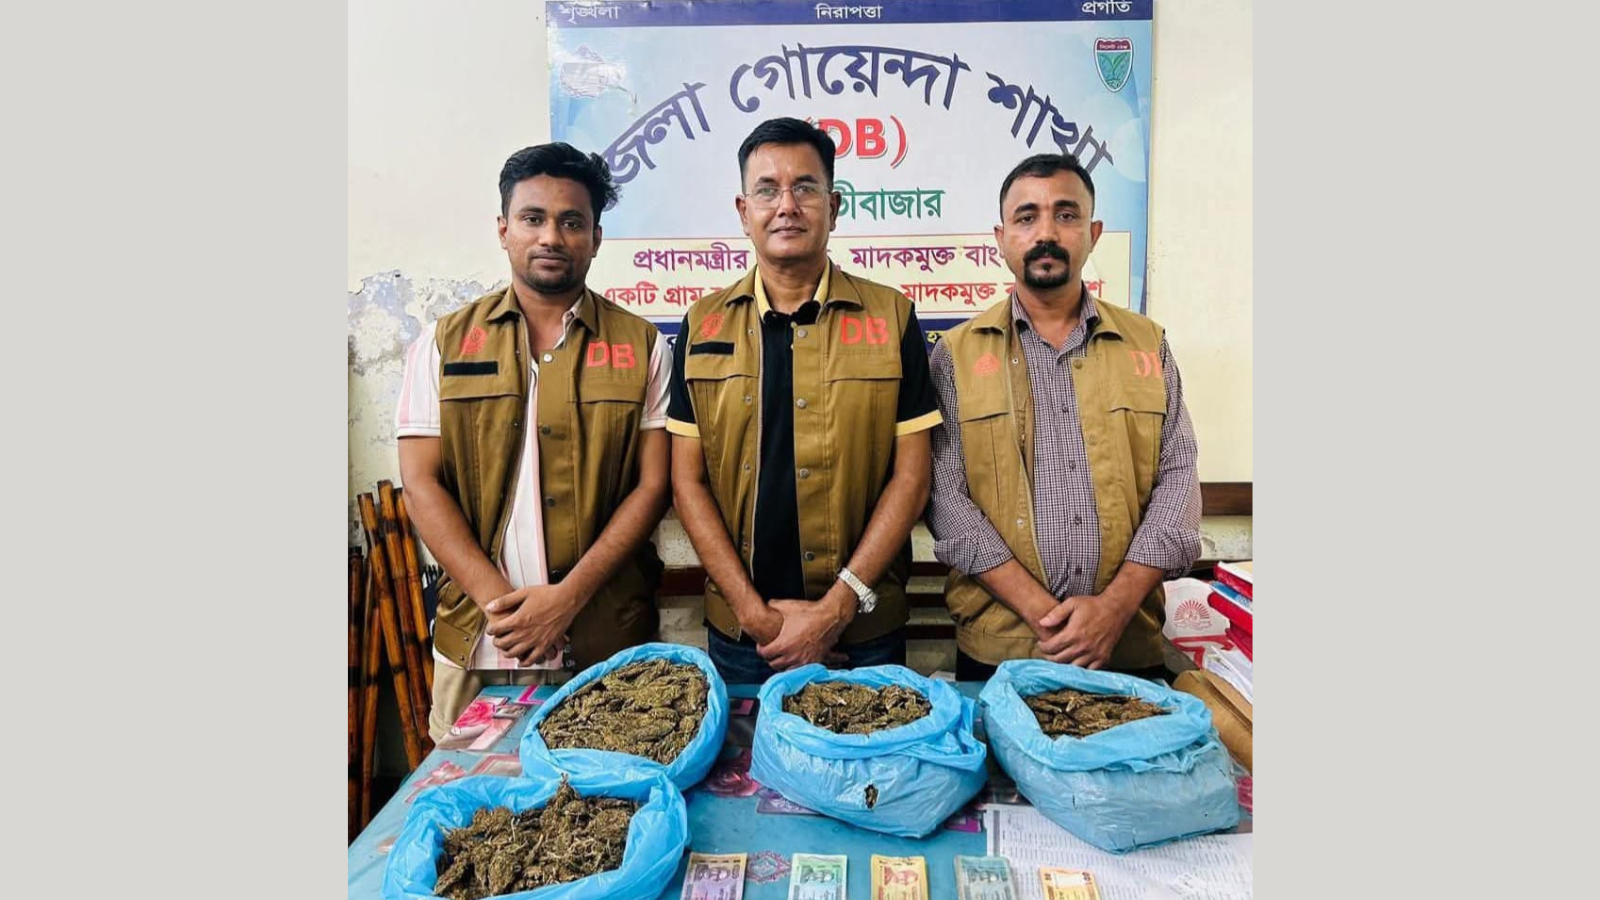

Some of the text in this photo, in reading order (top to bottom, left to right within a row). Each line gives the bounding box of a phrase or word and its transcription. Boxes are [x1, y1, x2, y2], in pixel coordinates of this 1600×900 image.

[814, 3, 883, 19] নিরাপত্তা
[729, 42, 971, 113] গোয়েন্দা
[806, 114, 908, 169] DB)
[633, 241, 750, 272] প্রধানমন্ত্রীর
[849, 246, 957, 273] মাদকমুক্ত
[901, 282, 997, 306] মাদকমুক্ত
[840, 315, 890, 345] DB
[586, 341, 636, 368] DB
